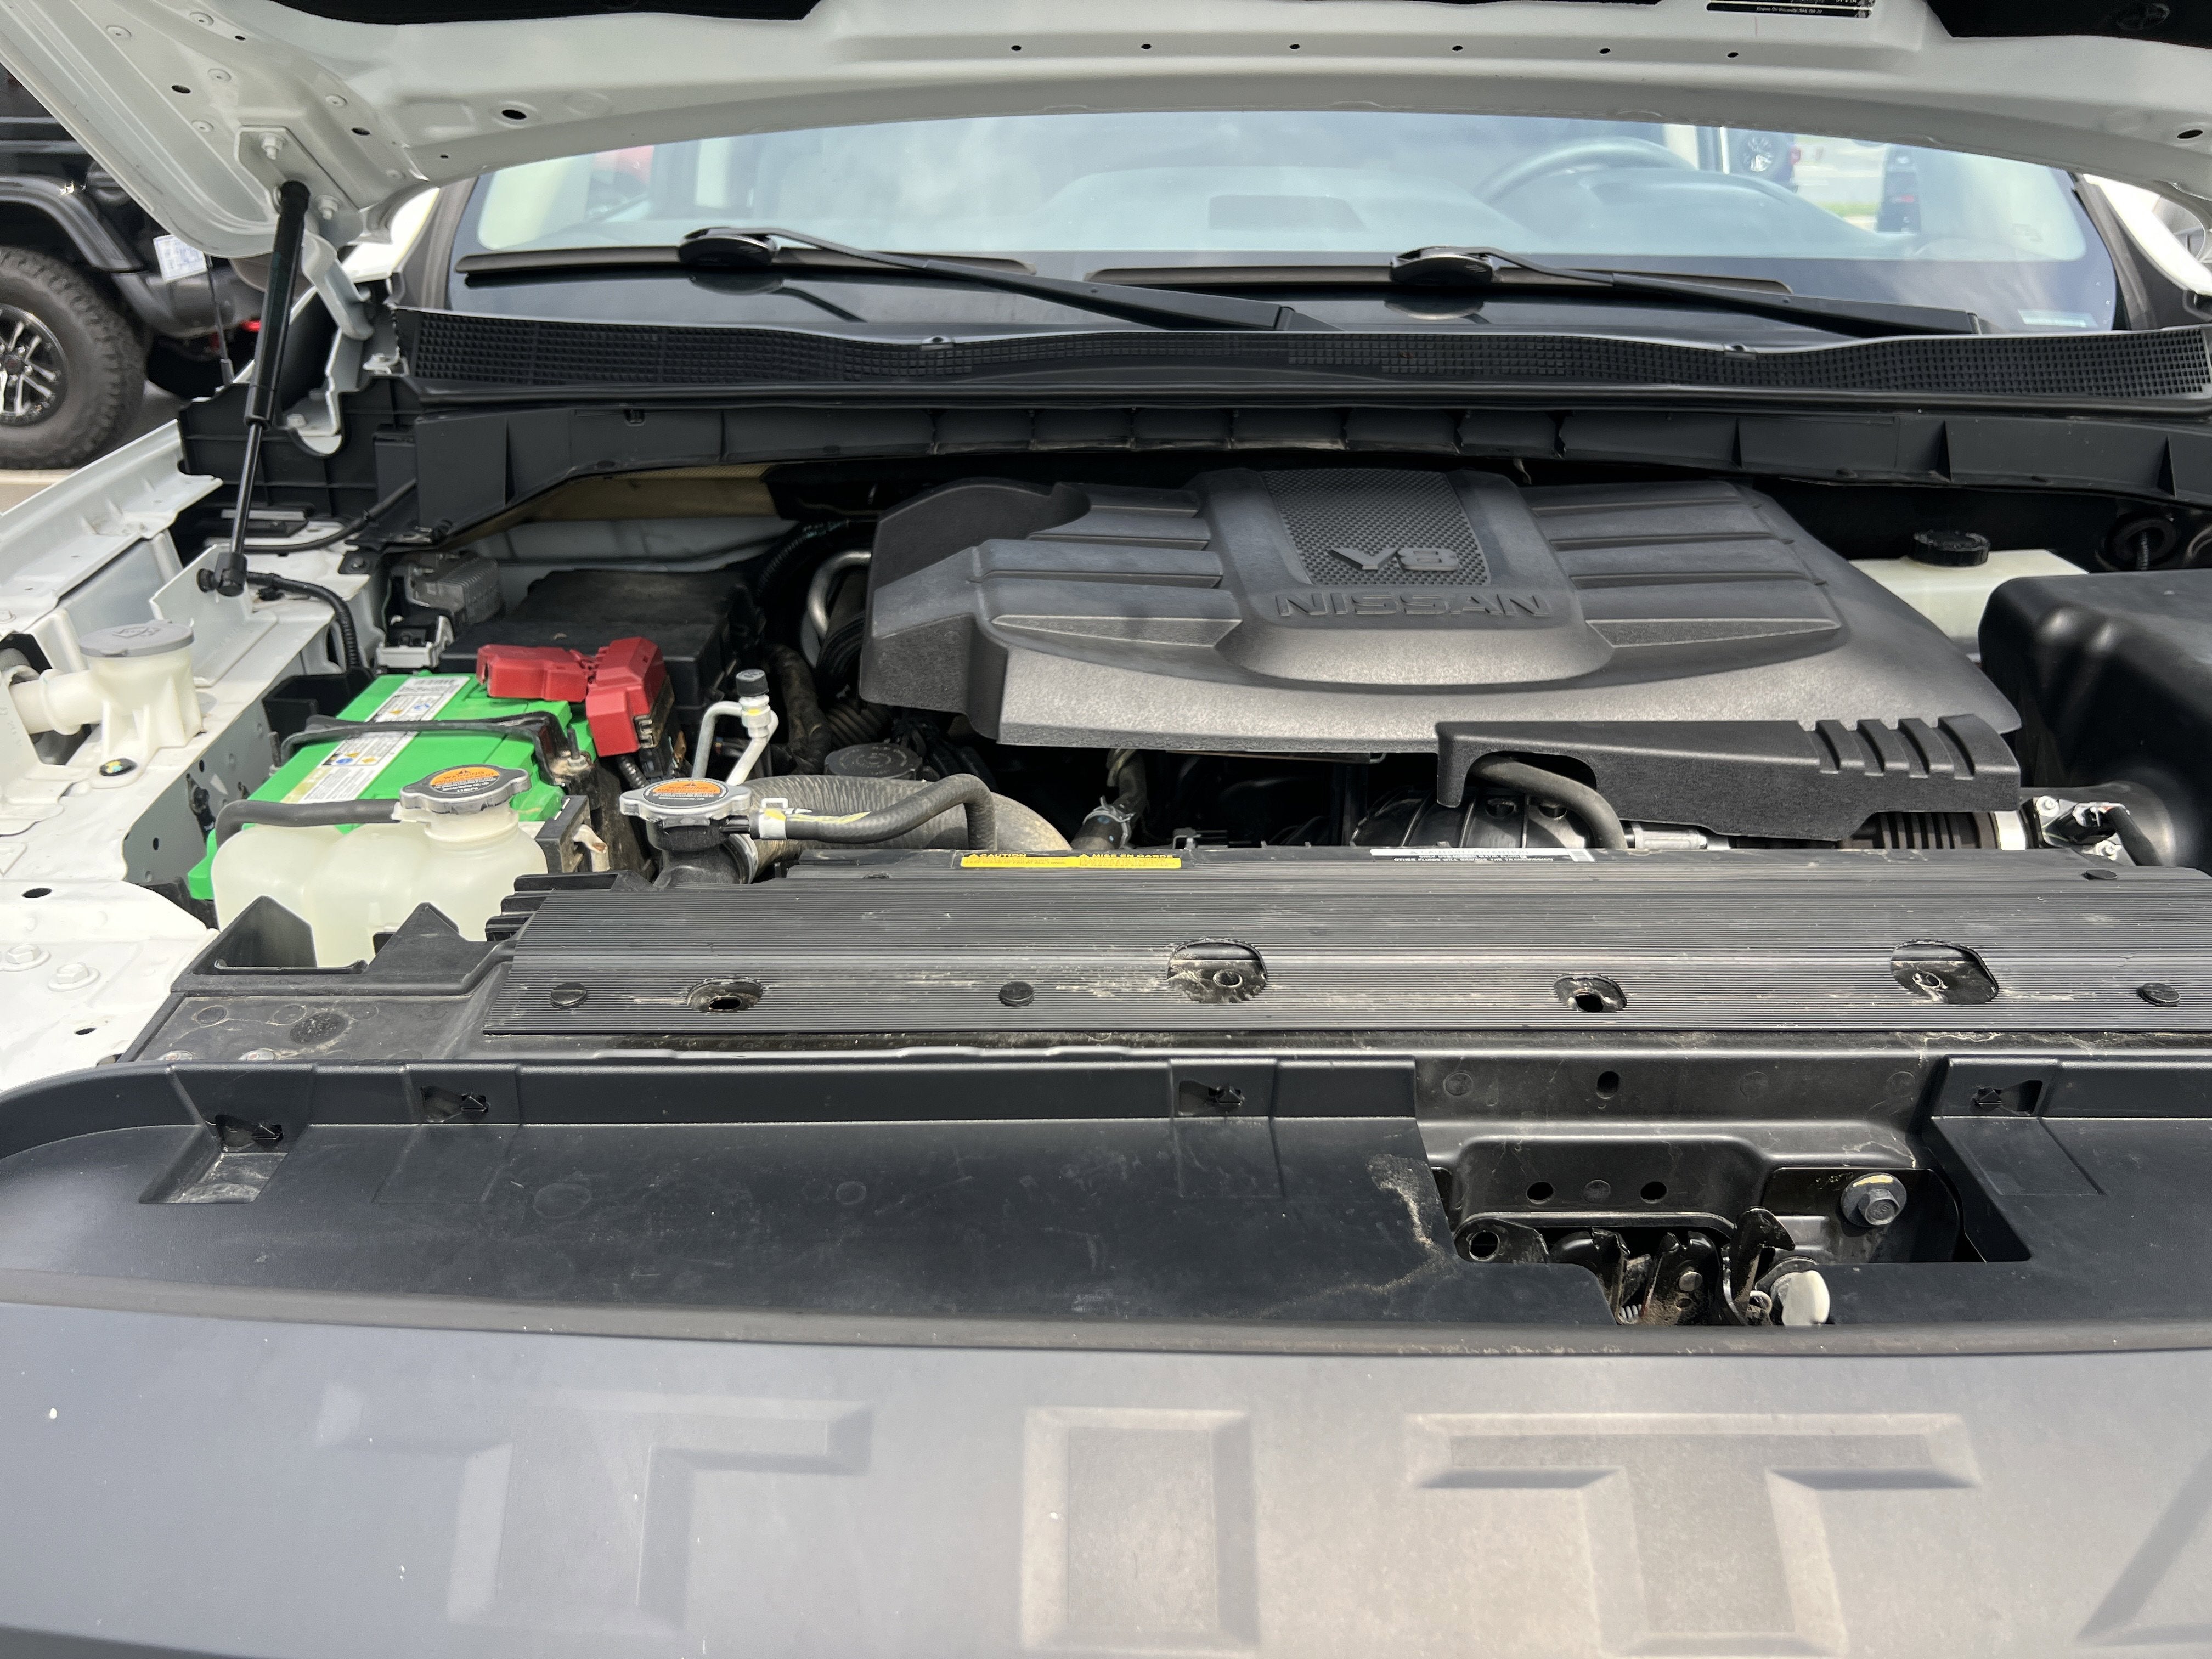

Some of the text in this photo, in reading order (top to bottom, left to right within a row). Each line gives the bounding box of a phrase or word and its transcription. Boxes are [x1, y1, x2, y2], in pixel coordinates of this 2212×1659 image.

[1328, 547, 1460, 572] V8
[1274, 592, 1550, 617] NISSAN
[315, 1381, 2212, 1657] TIT
